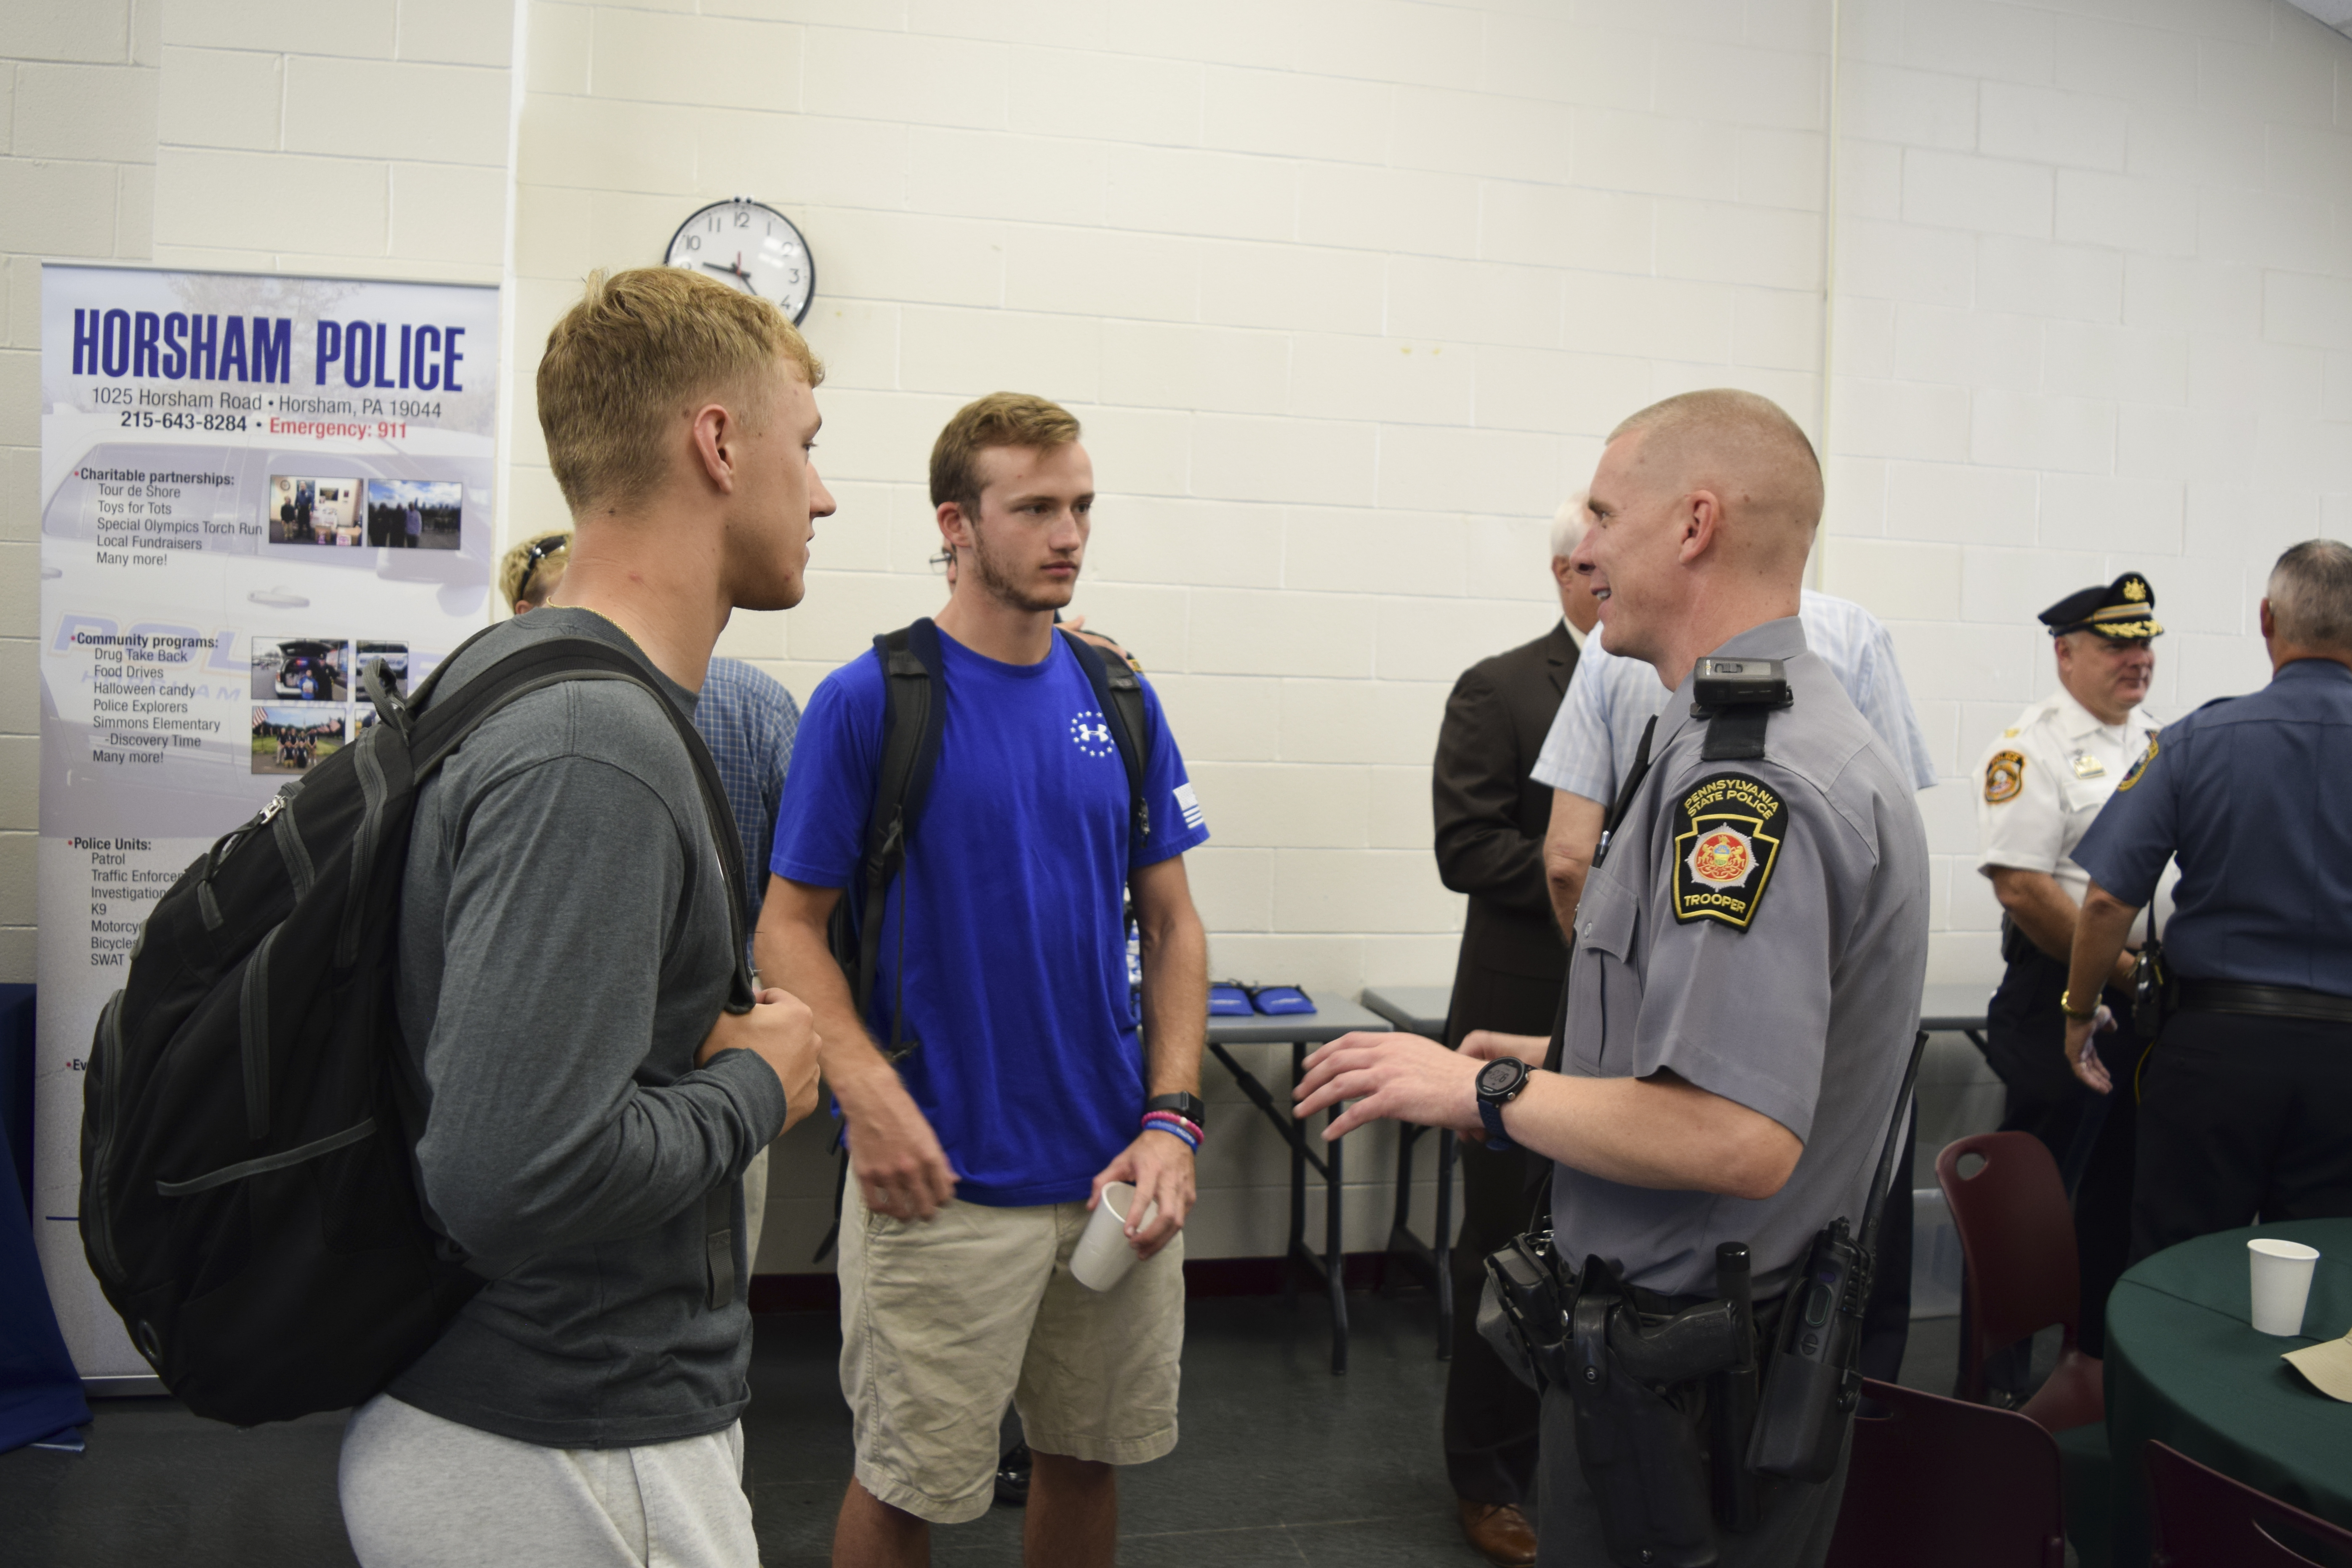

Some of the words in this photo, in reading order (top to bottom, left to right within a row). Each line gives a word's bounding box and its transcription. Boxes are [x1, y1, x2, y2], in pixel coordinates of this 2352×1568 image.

[708, 217, 721, 232] 11
[734, 212, 750, 227] 12
[686, 235, 701, 250] 10
[781, 242, 794, 256] 2
[788, 268, 799, 283] 3
[72, 309, 291, 384] HORSHAM
[315, 320, 465, 392] POLICE
[93, 387, 133, 405] 1025
[139, 389, 213, 408] Horsham
[220, 392, 261, 410] Road
[279, 395, 356, 416] Horsham,
[362, 398, 383, 415] PA
[391, 400, 441, 418] 19044
[121, 410, 247, 431] 215-643-8284
[270, 417, 371, 440] Emergency:
[378, 421, 406, 438] 911
[81, 468, 145, 482] Charitable
[149, 471, 234, 487] partnerships:
[98, 482, 124, 496] Tour
[127, 485, 142, 497] de
[146, 484, 181, 498] Shore
[97, 500, 124, 516] Toys
[128, 501, 144, 514] for
[147, 501, 172, 515] Tots
[97, 517, 140, 532] Special
[144, 519, 199, 535] Olympics
[202, 521, 235, 535] Torch
[239, 522, 262, 535] Run
[97, 534, 128, 547] Local
[132, 535, 202, 550] Fundraisers
[97, 551, 129, 567] Many
[133, 554, 167, 565] more!
[77, 632, 148, 648] Community
[152, 636, 218, 650] programs:
[95, 647, 123, 663] Drug
[126, 648, 154, 661] Take
[158, 650, 188, 662] Back
[94, 664, 122, 678] Food
[126, 665, 164, 679] Drives
[94, 681, 155, 695] Halloween
[159, 684, 195, 698] candy
[93, 698, 128, 711] Police
[132, 699, 188, 714] Explorers
[93, 716, 149, 731] Simmons
[153, 717, 220, 733] Elementary
[105, 732, 168, 748] -Discovery
[172, 735, 202, 748] Time
[93, 750, 125, 765] Many
[129, 752, 164, 764] more!
[1684, 779, 1779, 813] PENNSYLVANIA
[1687, 791, 1723, 817] STATE
[1726, 790, 1774, 820] POLICE
[74, 836, 111, 850] Police
[115, 838, 151, 850] Units:
[92, 852, 125, 865] Patrol
[91, 869, 128, 882] Traffic
[91, 903, 107, 915] K9
[1684, 893, 1747, 914] TROOPER
[91, 919, 141, 934] Motorcy
[91, 953, 124, 966] SWAT
